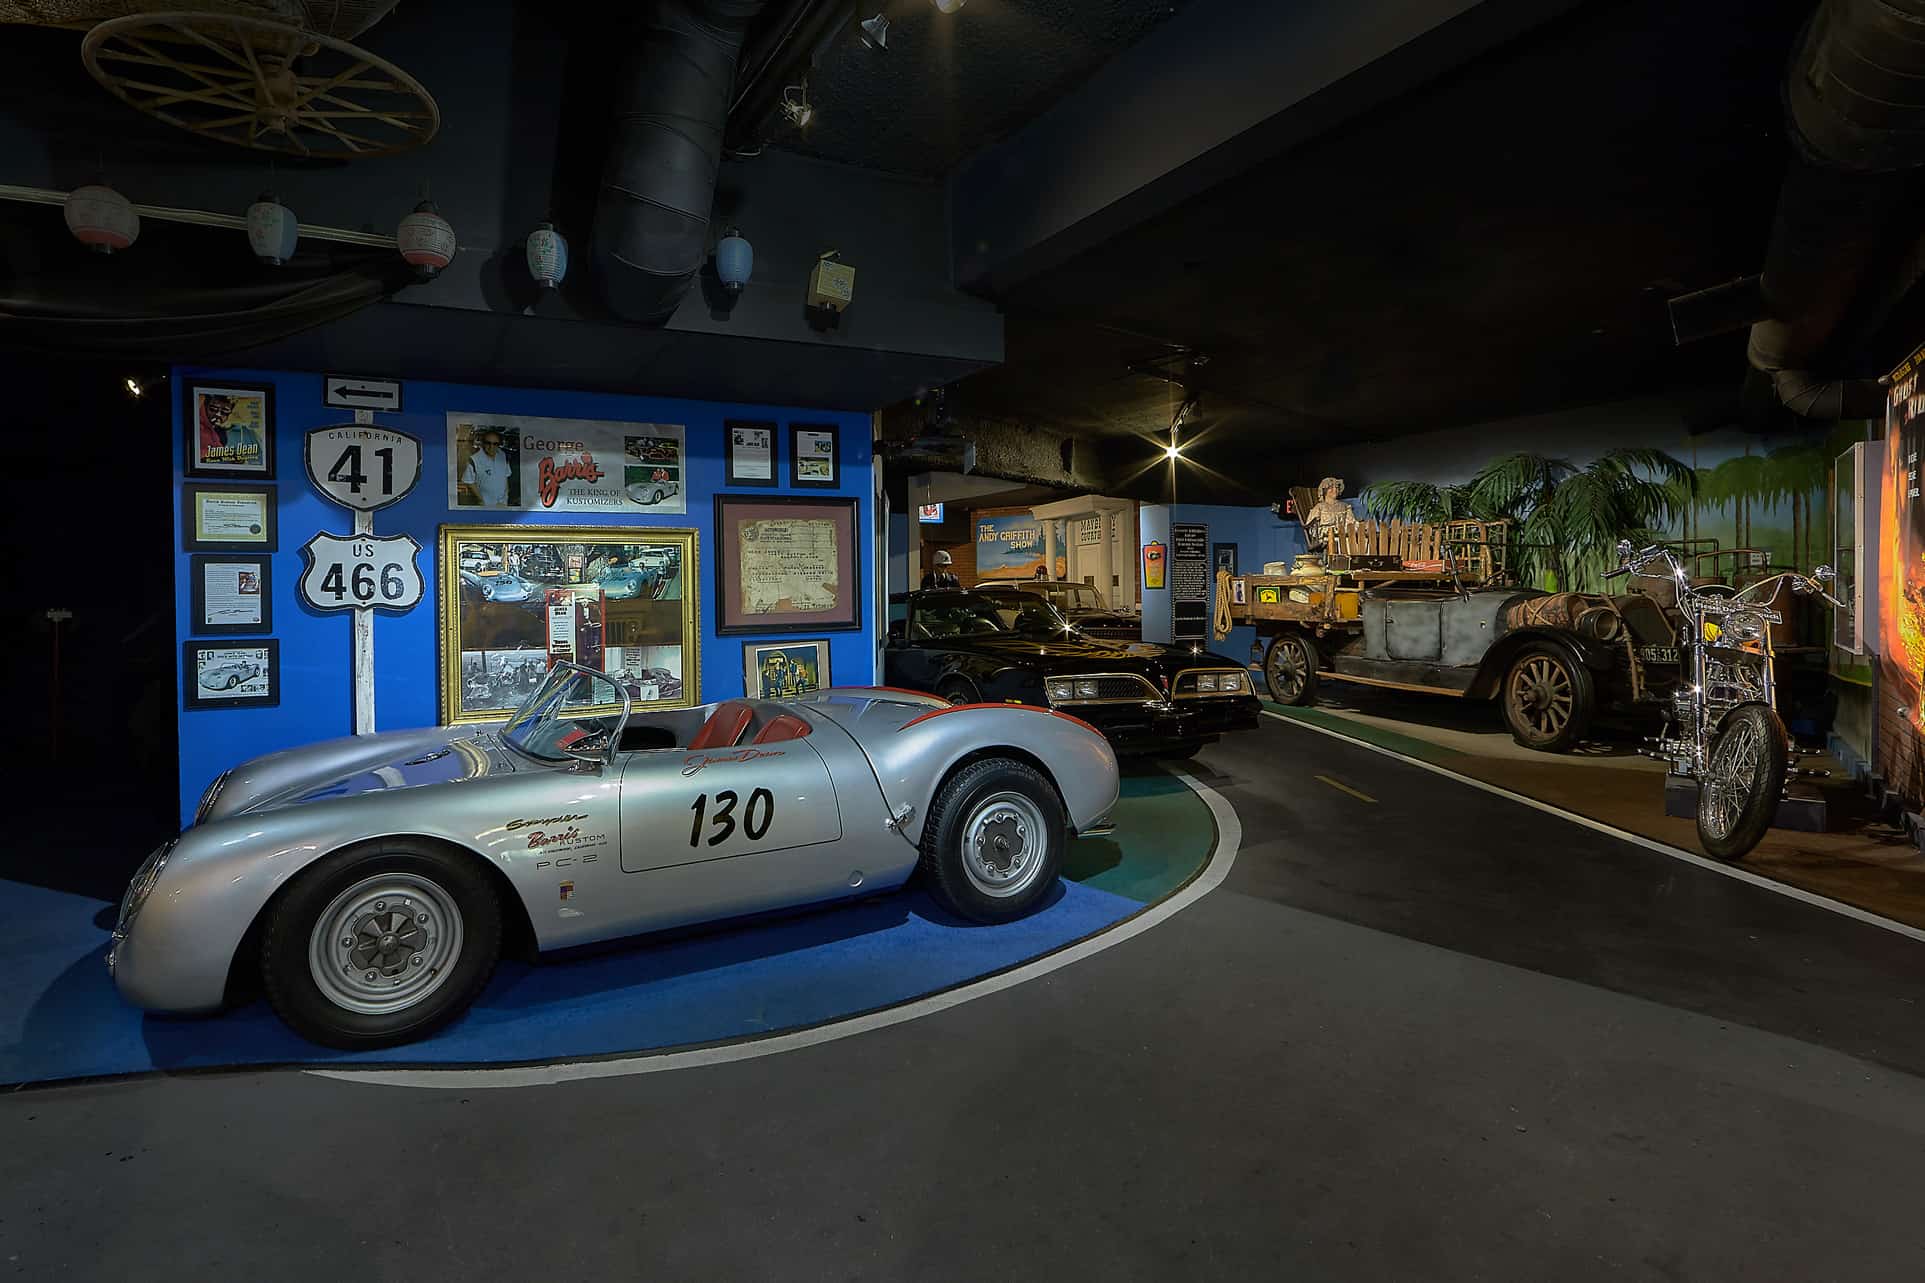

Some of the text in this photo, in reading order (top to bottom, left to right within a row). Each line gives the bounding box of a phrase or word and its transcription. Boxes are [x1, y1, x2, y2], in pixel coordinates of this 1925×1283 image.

[328, 431, 402, 444] CALIFORNIA
[523, 435, 584, 452] George
[205, 442, 258, 458] James Dean
[327, 445, 393, 495] 41
[538, 452, 605, 508] Barris
[568, 488, 621, 498] THE KING OF
[566, 497, 623, 506] KUSTOMIZERS
[979, 524, 994, 532] THE
[979, 529, 1035, 542] ANDY GRIFFITH
[352, 544, 374, 557] US
[1010, 540, 1033, 549] SHOW
[320, 562, 404, 601] 466
[690, 787, 775, 848] 130
[528, 826, 579, 849] Barris
[560, 833, 606, 846] KUSTOM
